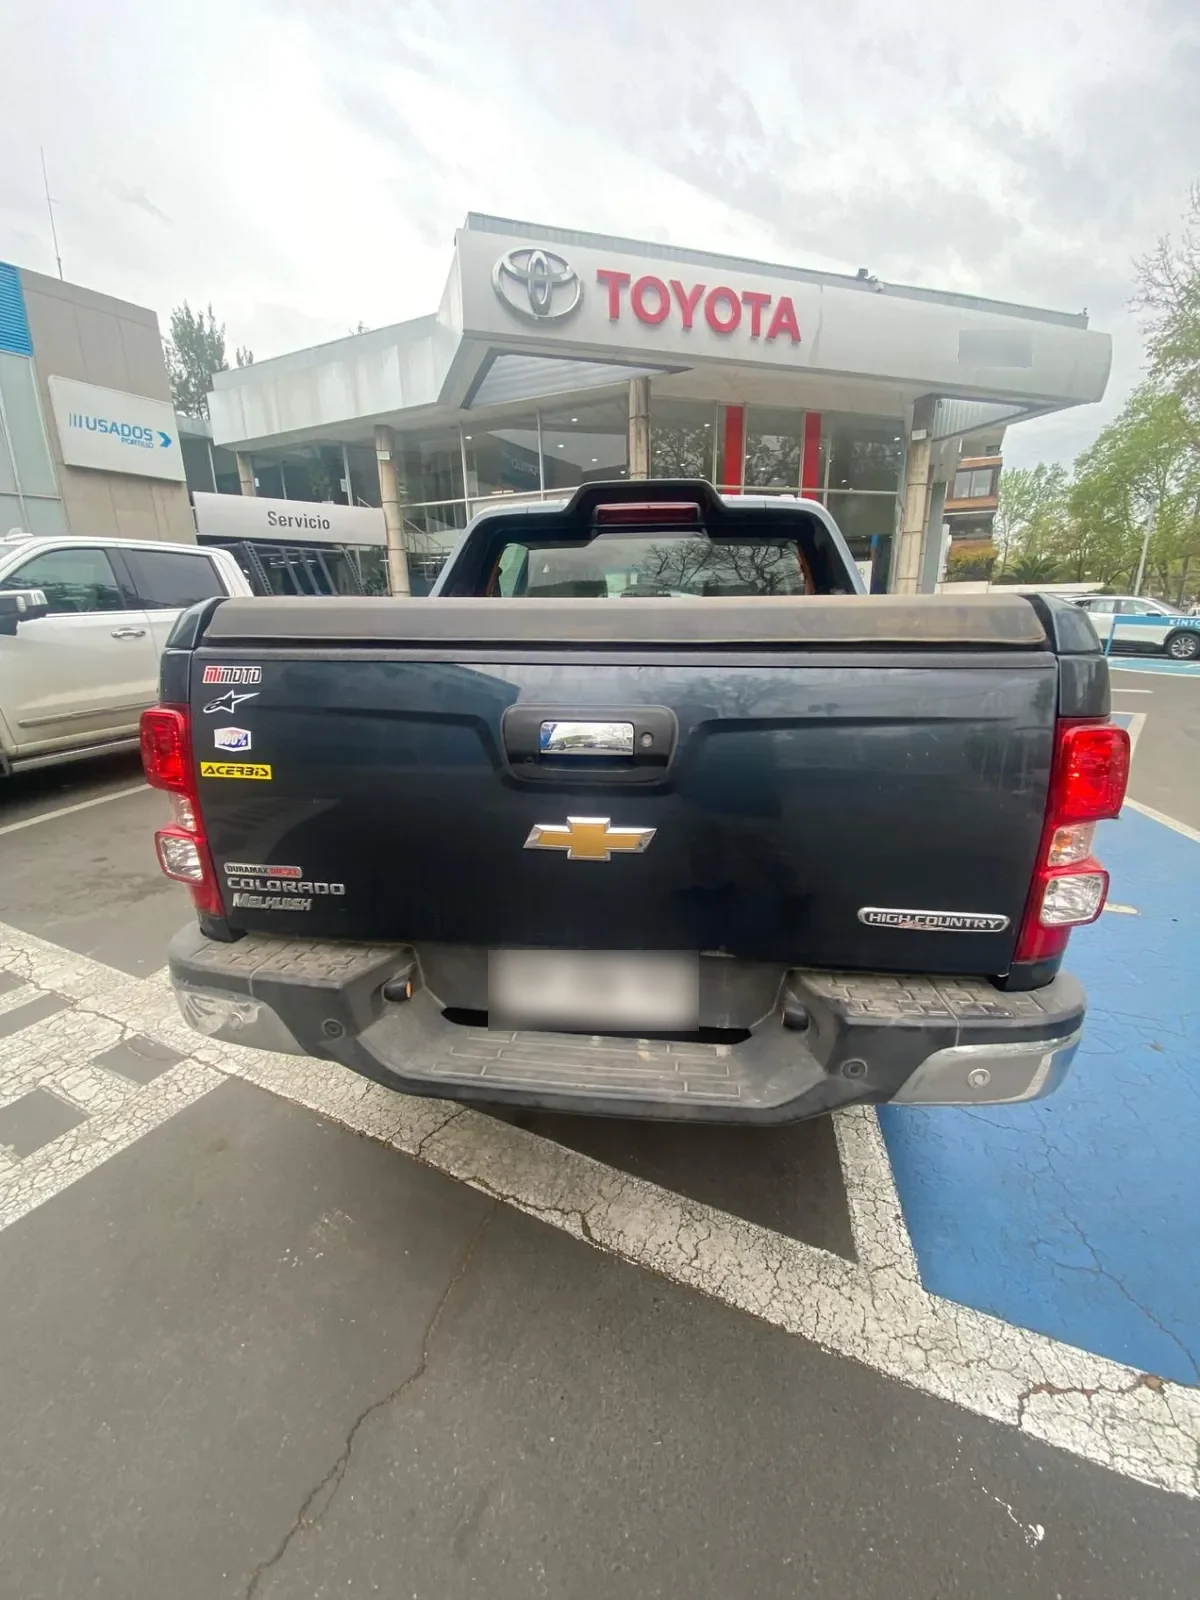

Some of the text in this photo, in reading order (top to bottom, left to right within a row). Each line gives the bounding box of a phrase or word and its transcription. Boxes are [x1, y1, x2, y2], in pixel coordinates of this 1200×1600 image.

[596, 268, 801, 344] TOYOTA
[85, 416, 153, 442] USADOS
[267, 510, 331, 530] Servicio
[227, 864, 269, 874] DURAMAX
[227, 877, 346, 896] COLORADO
[869, 912, 1000, 929] HIGH COUNTRY
